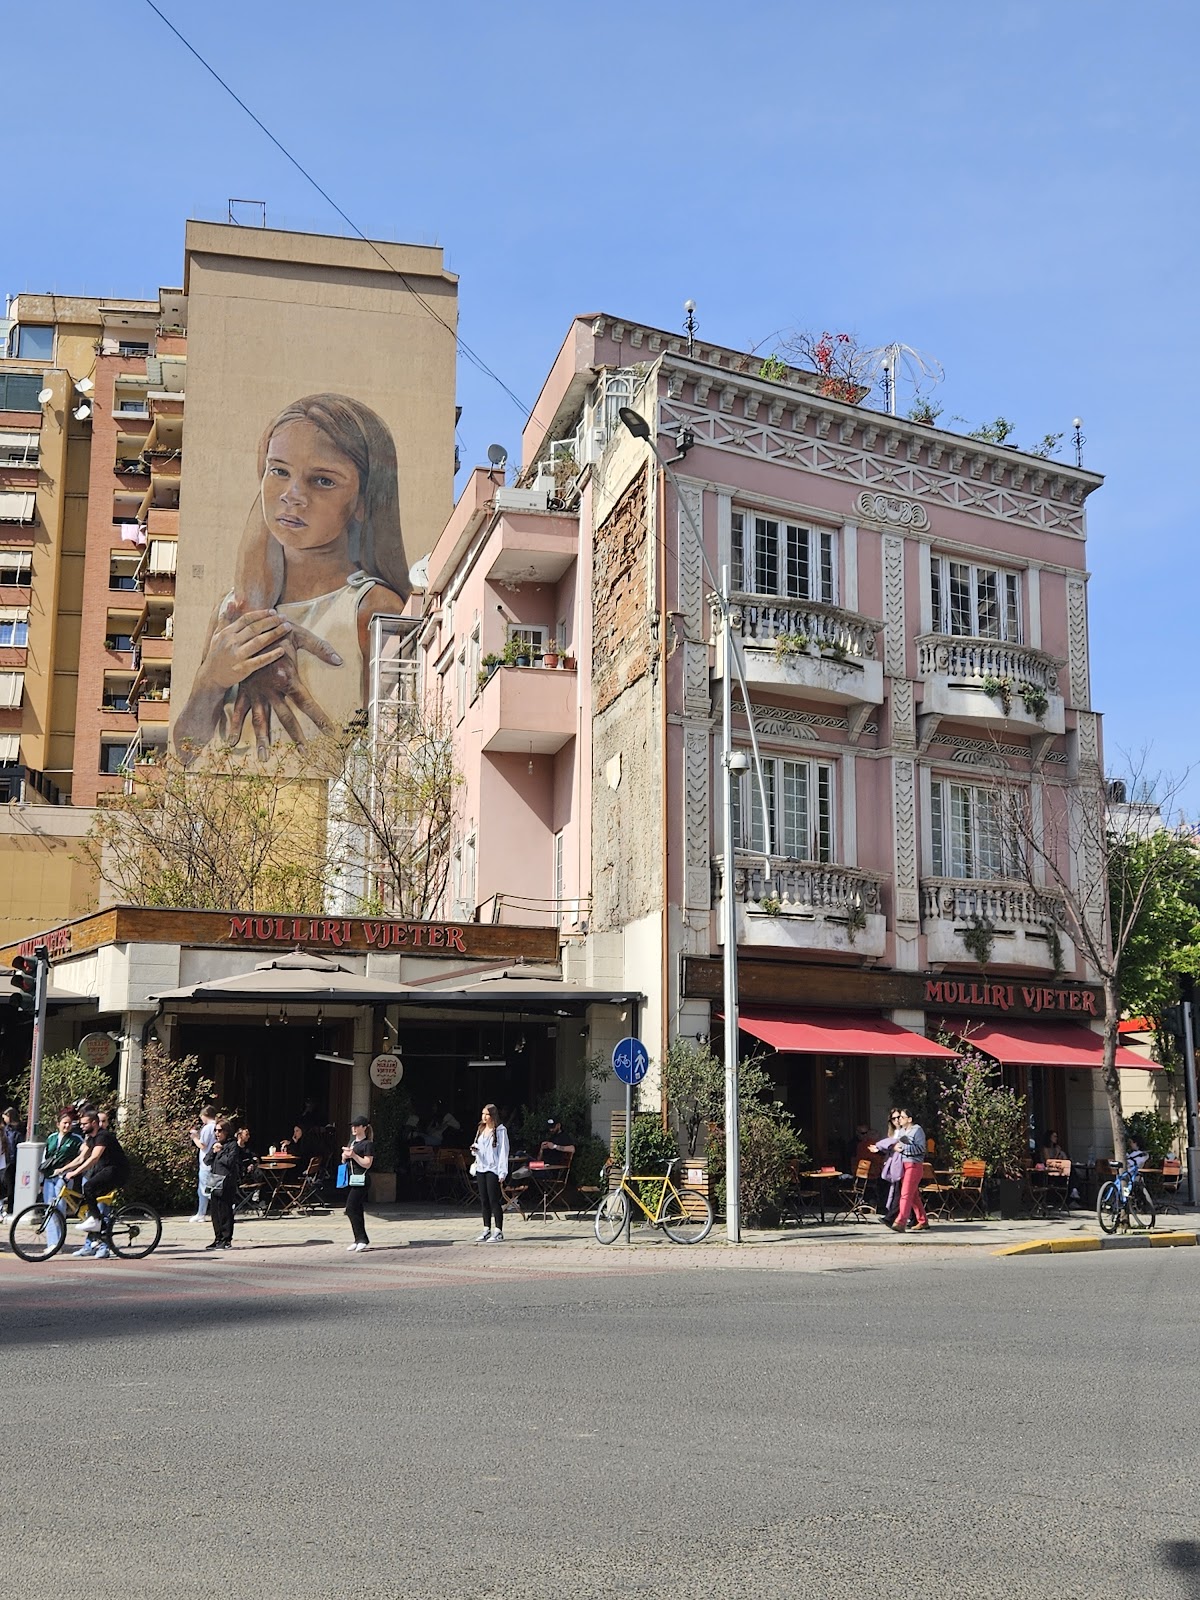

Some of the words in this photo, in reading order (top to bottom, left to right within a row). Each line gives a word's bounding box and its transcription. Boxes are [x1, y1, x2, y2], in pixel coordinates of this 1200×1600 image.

[229, 916, 352, 947] MULLIRI
[361, 922, 467, 953] VJETER
[924, 980, 1015, 1011] MULLIRI
[1021, 986, 1098, 1017] VJETER
